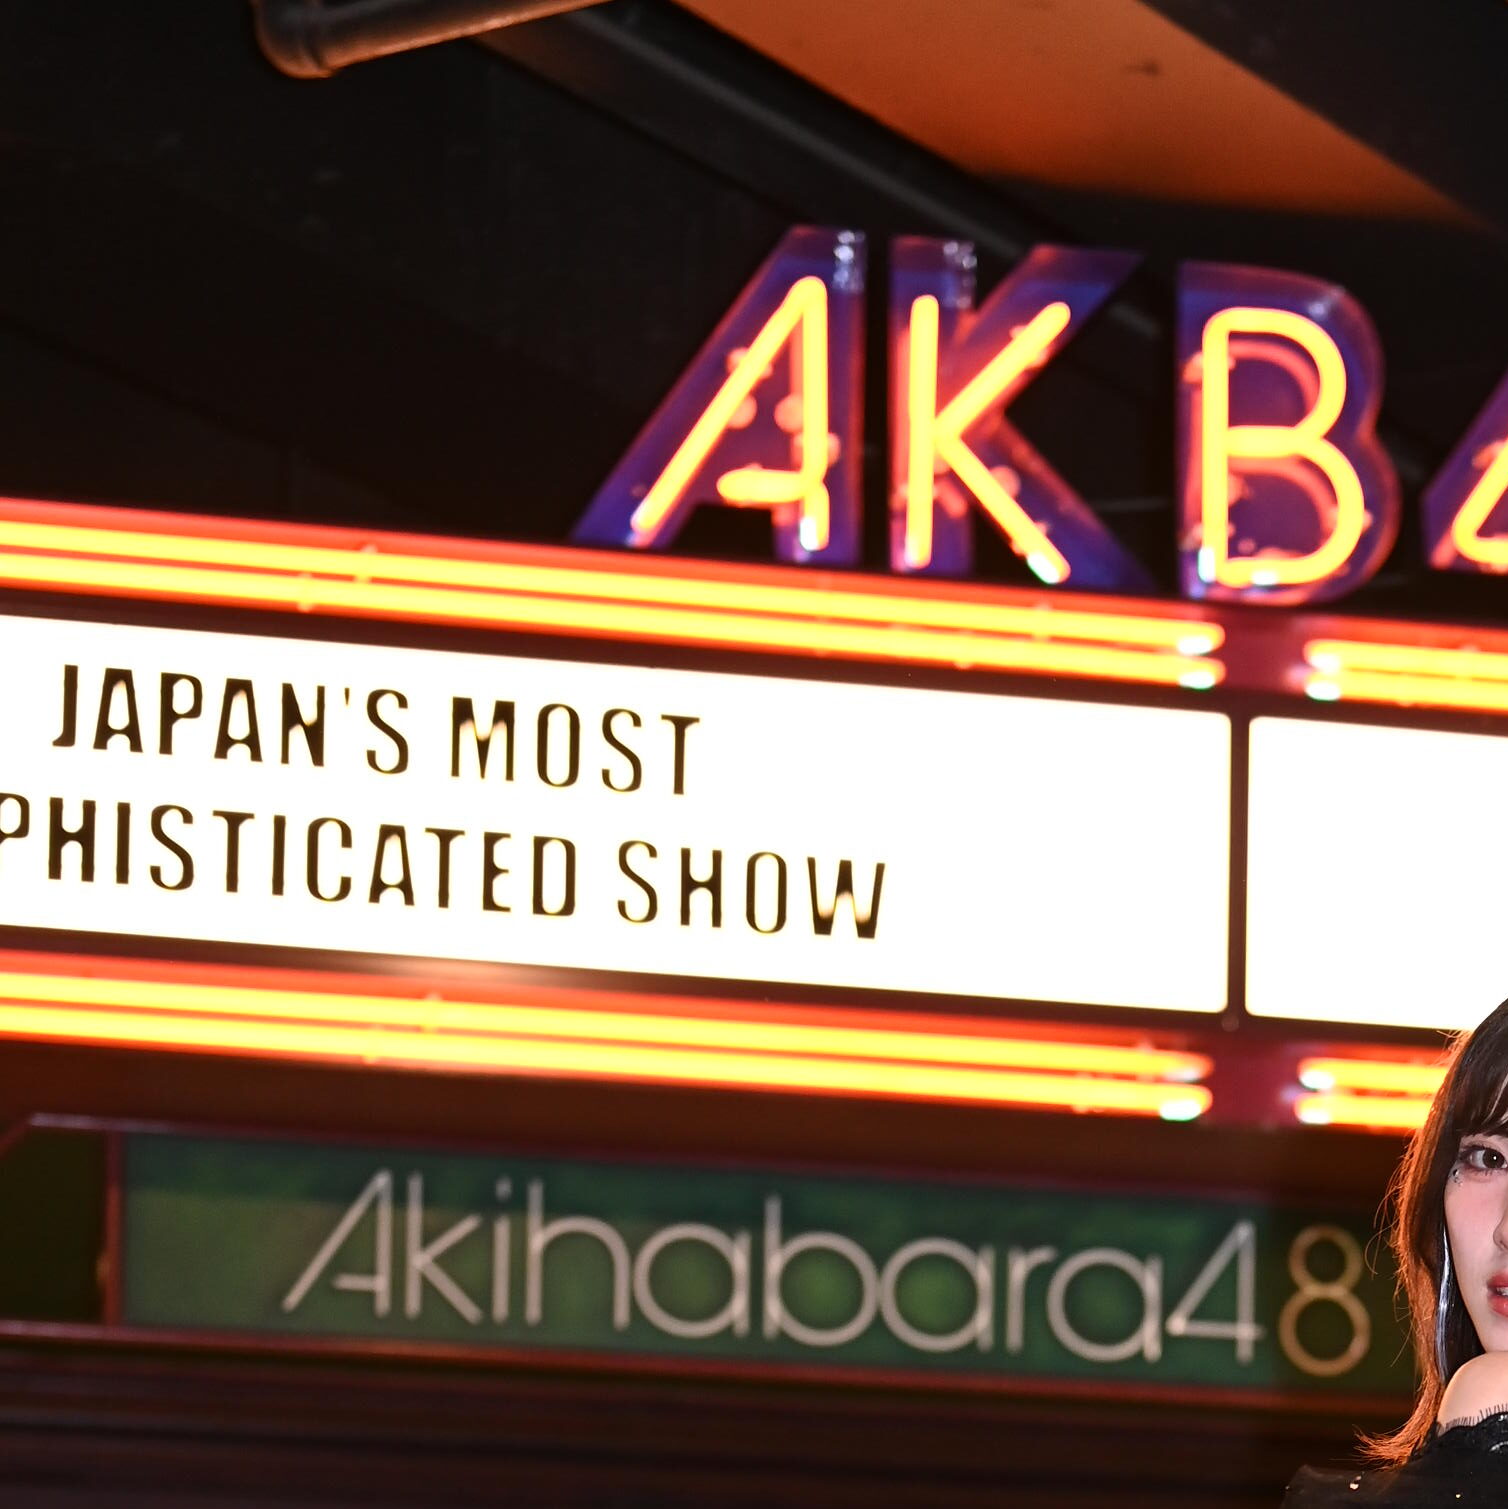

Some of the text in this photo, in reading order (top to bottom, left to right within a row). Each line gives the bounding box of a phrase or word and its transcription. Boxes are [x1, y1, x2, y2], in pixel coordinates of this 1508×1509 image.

[52, 664, 700, 796] JAPAN'S MOST
[0, 791, 886, 940] PHISTICATED SHOW
[281, 1169, 1372, 1377] Akihabara48
